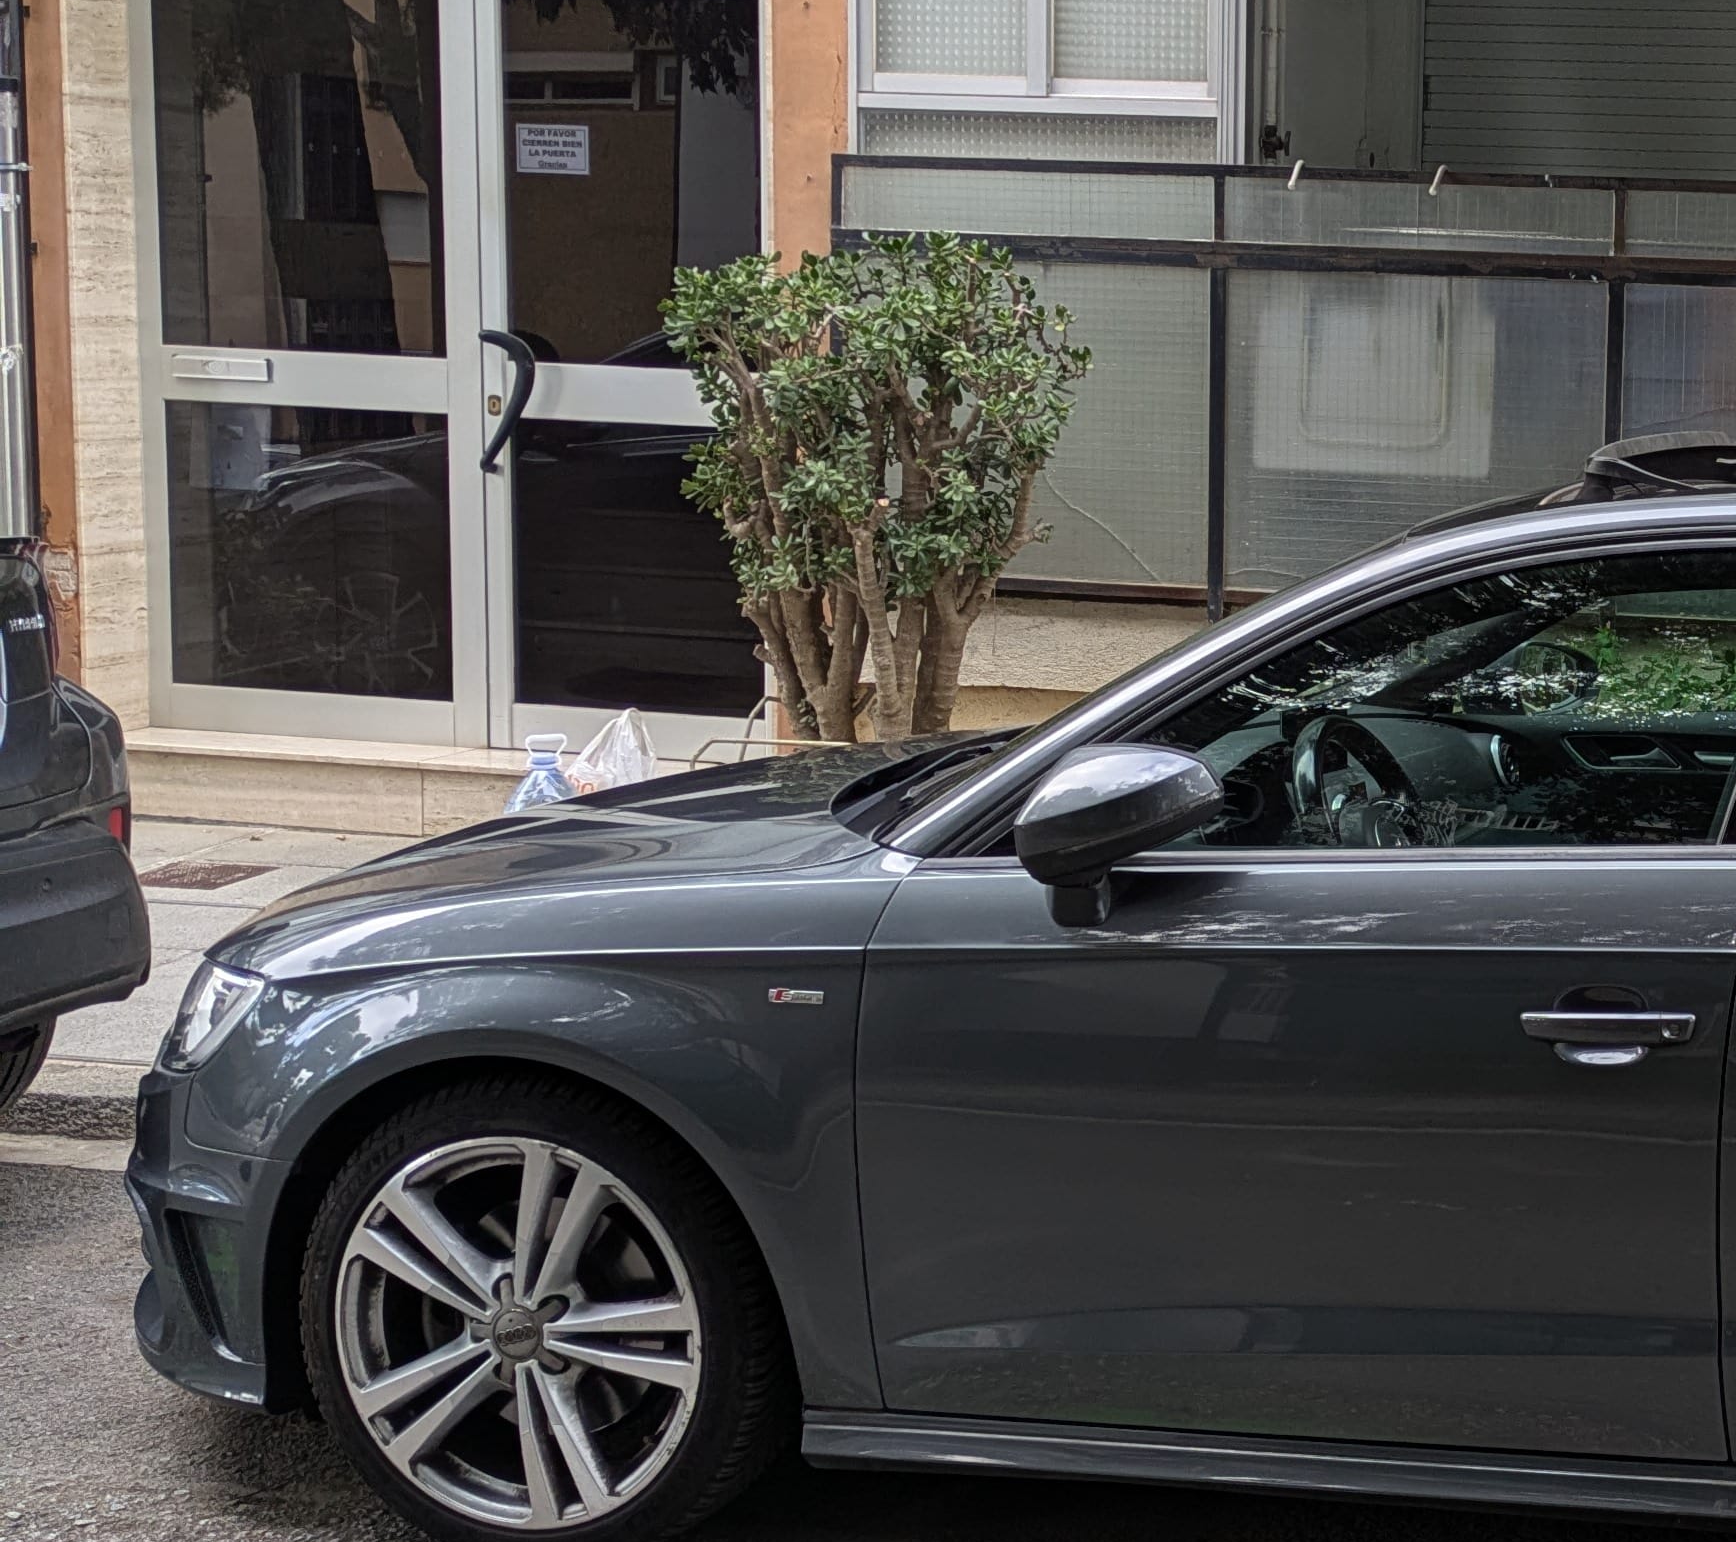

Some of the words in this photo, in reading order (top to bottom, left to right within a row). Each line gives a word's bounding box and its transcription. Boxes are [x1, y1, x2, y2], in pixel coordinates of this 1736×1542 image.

[527, 128, 545, 137] POR
[547, 129, 577, 138] FAVOR
[562, 140, 583, 148] BIEN
[528, 148, 540, 157] LA
[542, 149, 577, 157] PUERTA
